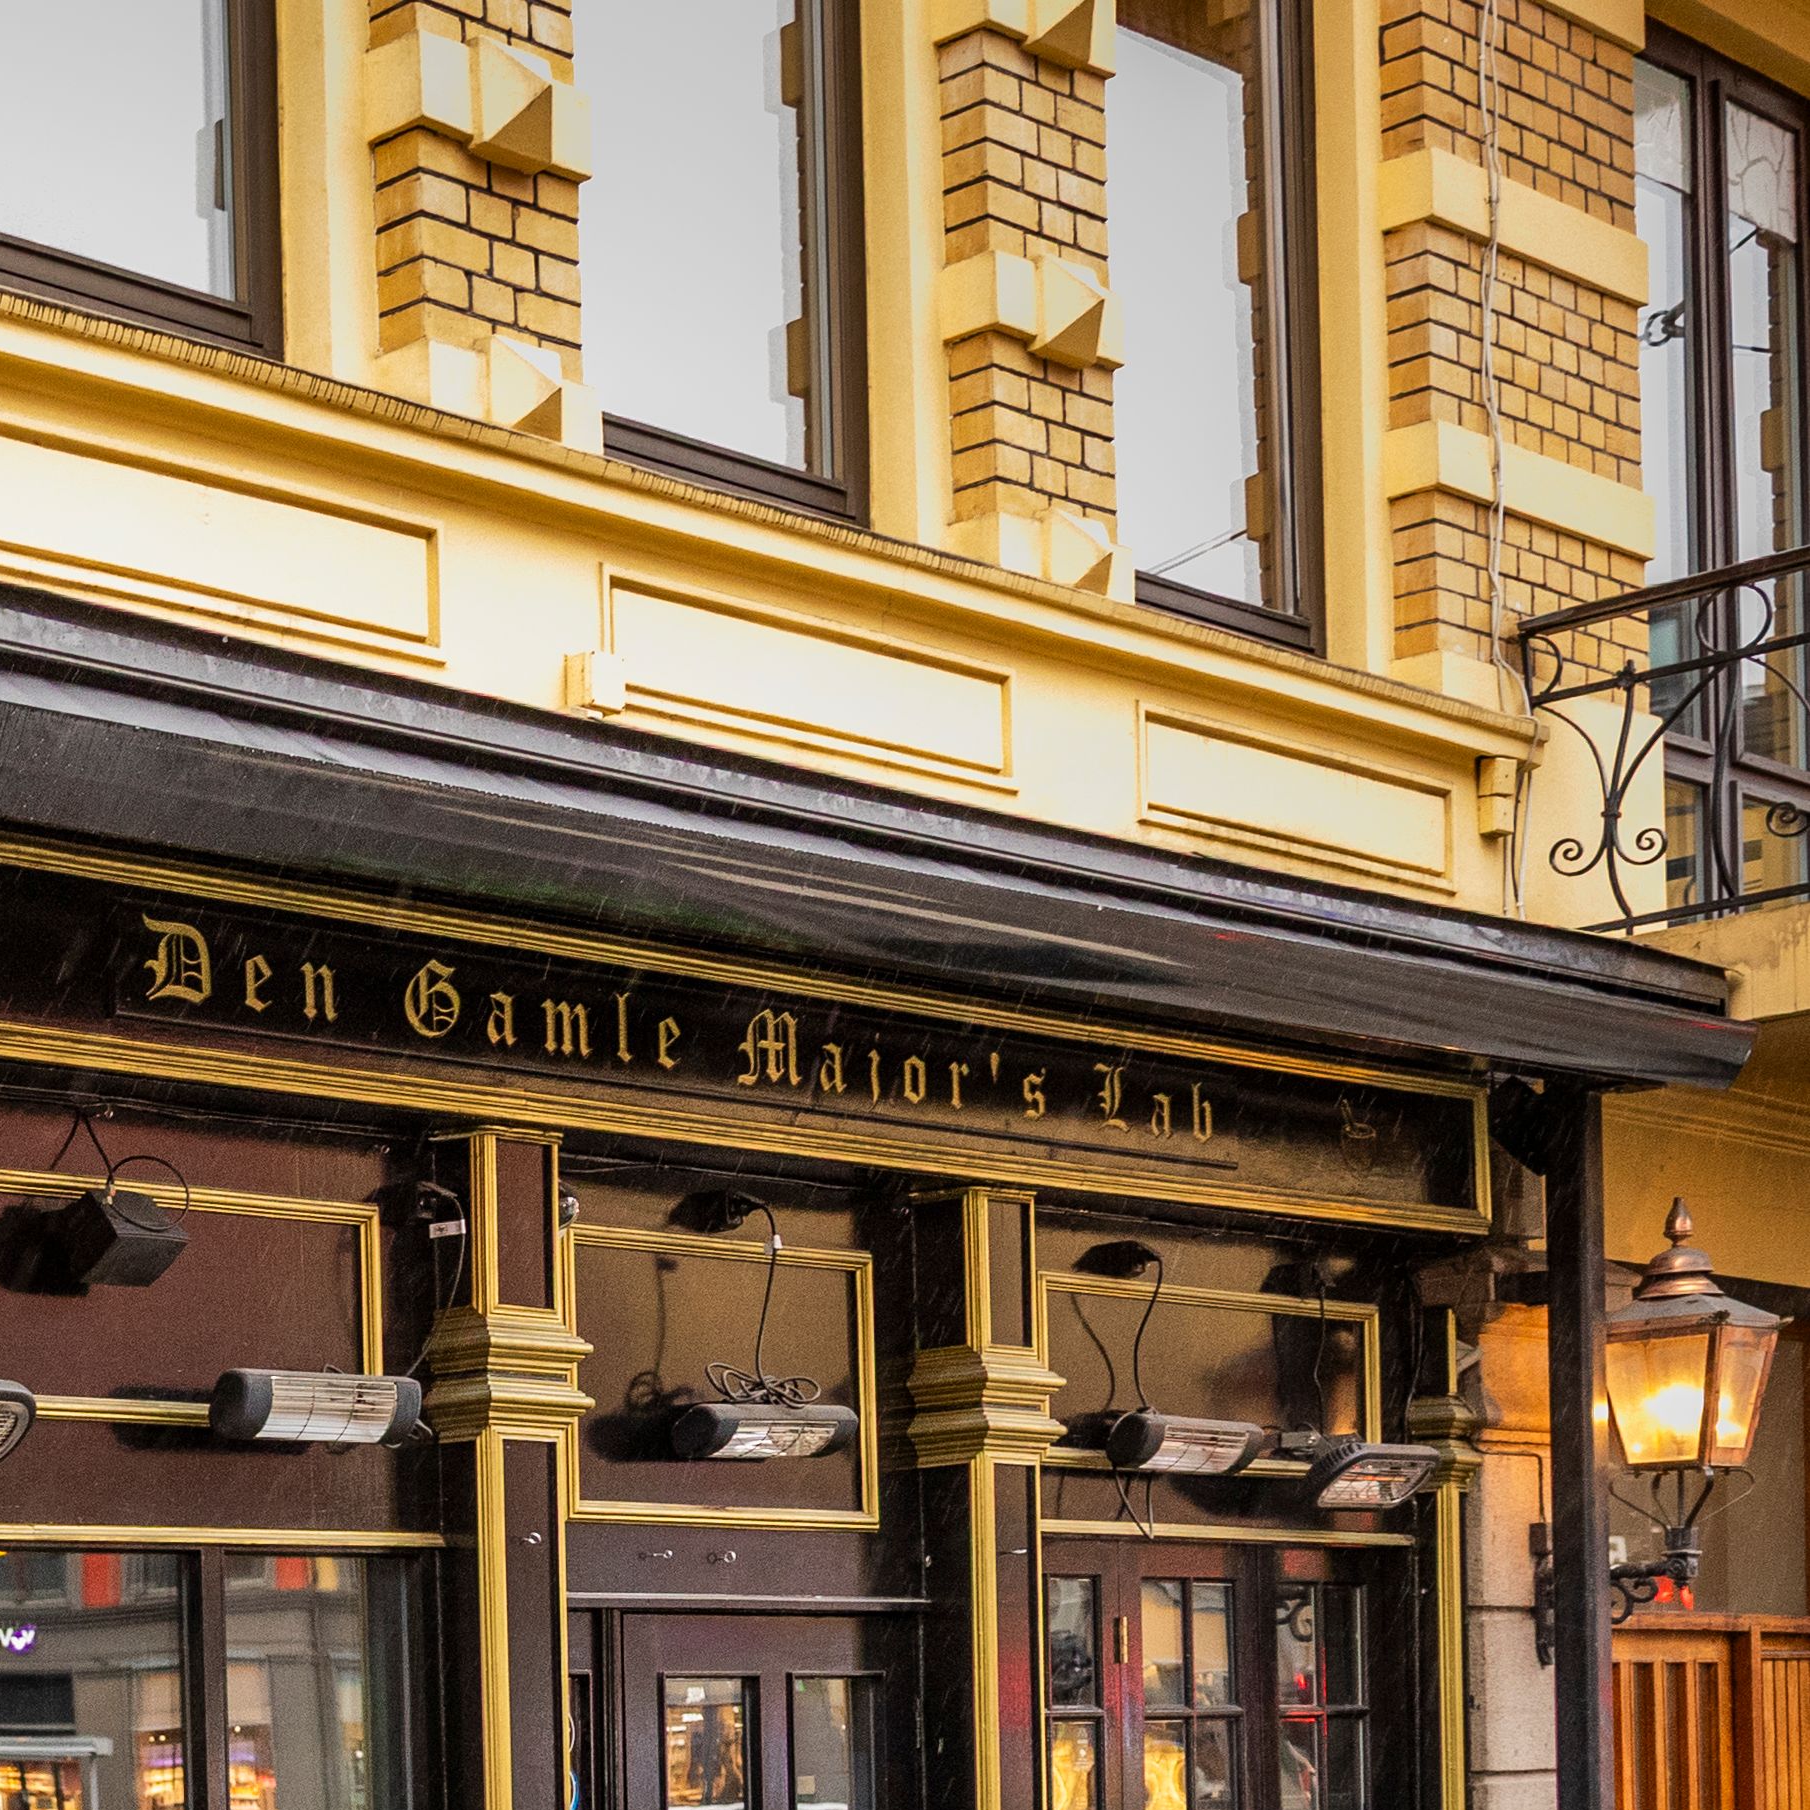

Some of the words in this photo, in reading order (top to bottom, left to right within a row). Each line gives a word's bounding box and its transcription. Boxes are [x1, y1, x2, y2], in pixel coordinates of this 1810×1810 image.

[142, 913, 340, 1023] Den
[404, 959, 682, 1071] Gamle
[737, 1007, 1047, 1121] Major's
[1094, 1062, 1214, 1144] Lab
